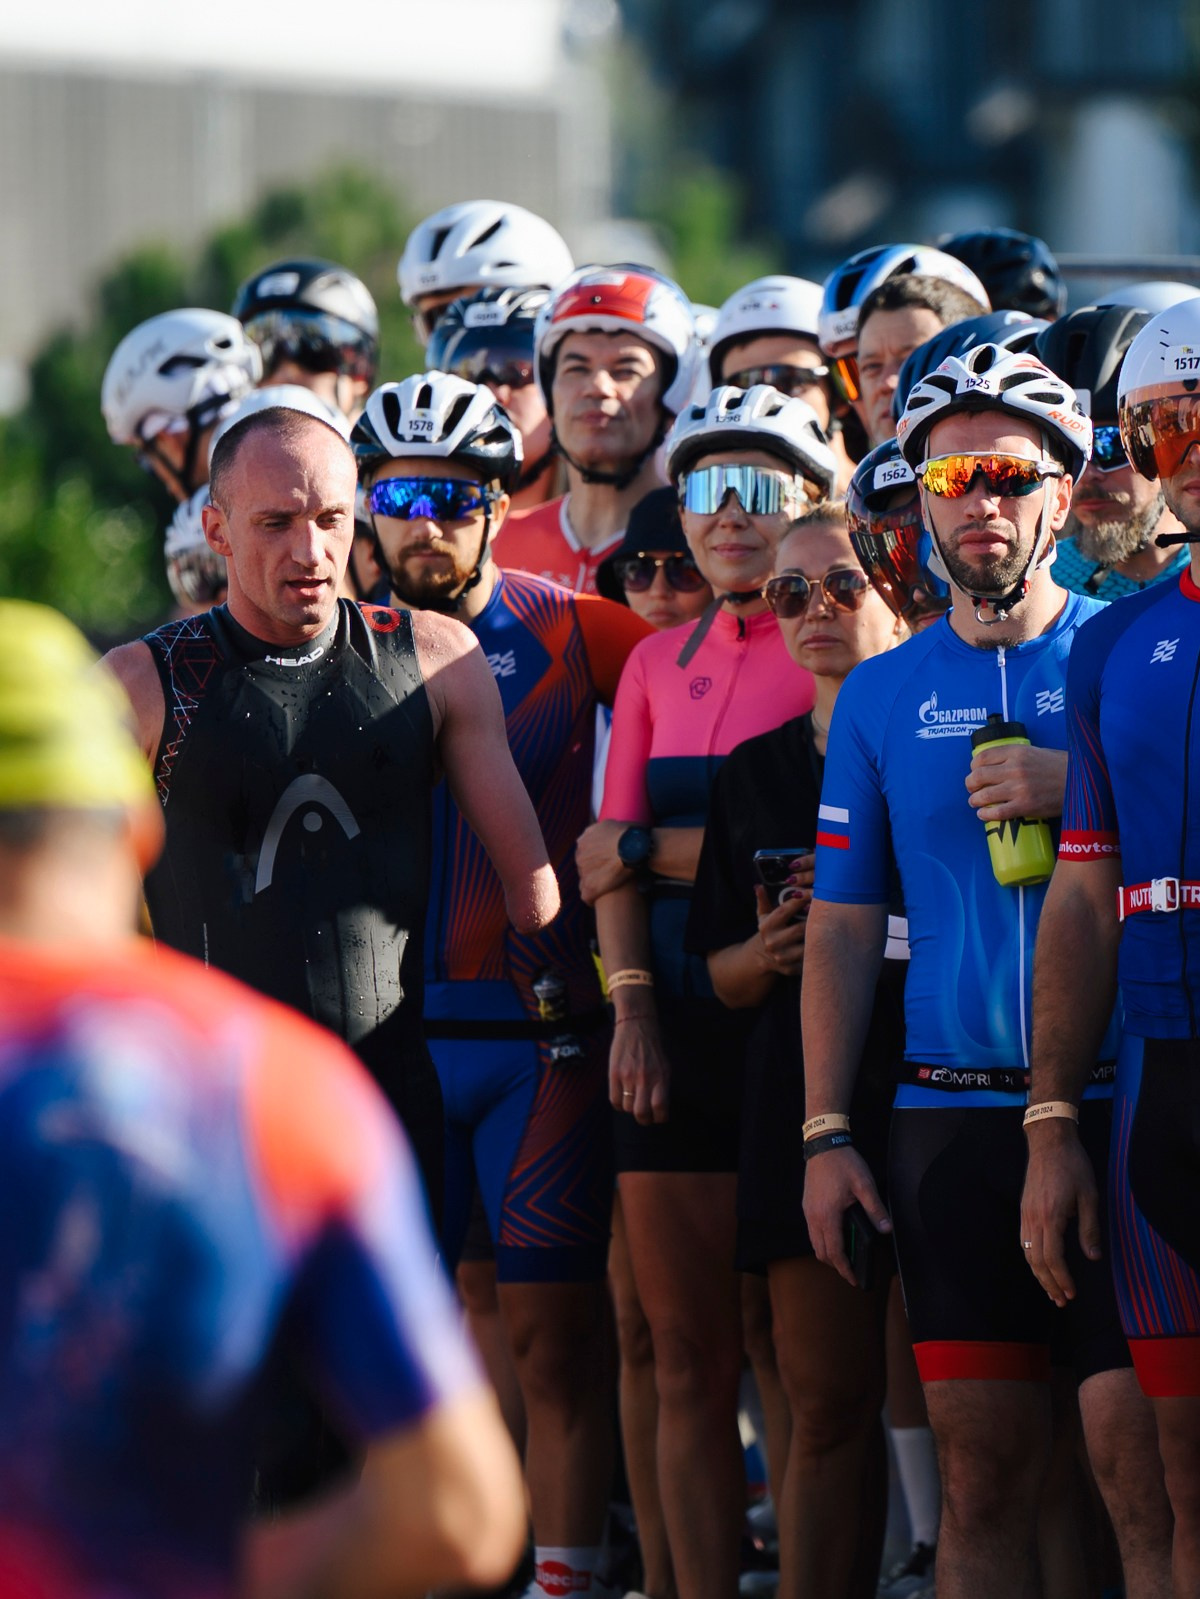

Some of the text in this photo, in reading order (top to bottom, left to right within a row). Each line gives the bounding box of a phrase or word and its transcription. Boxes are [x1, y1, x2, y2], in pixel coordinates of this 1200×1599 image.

[1174, 357, 1200, 370] 1517
[965, 378, 990, 390] 1525
[409, 420, 433, 431] 1578
[1047, 410, 1086, 432] RUDY
[882, 467, 907, 482] 1562
[265, 646, 324, 667] HEAD
[939, 707, 988, 724] GAZPROM
[928, 727, 967, 735] TRIATHLON
[1041, 1106, 1053, 1114] 2024
[813, 1118, 825, 1128] 2024
